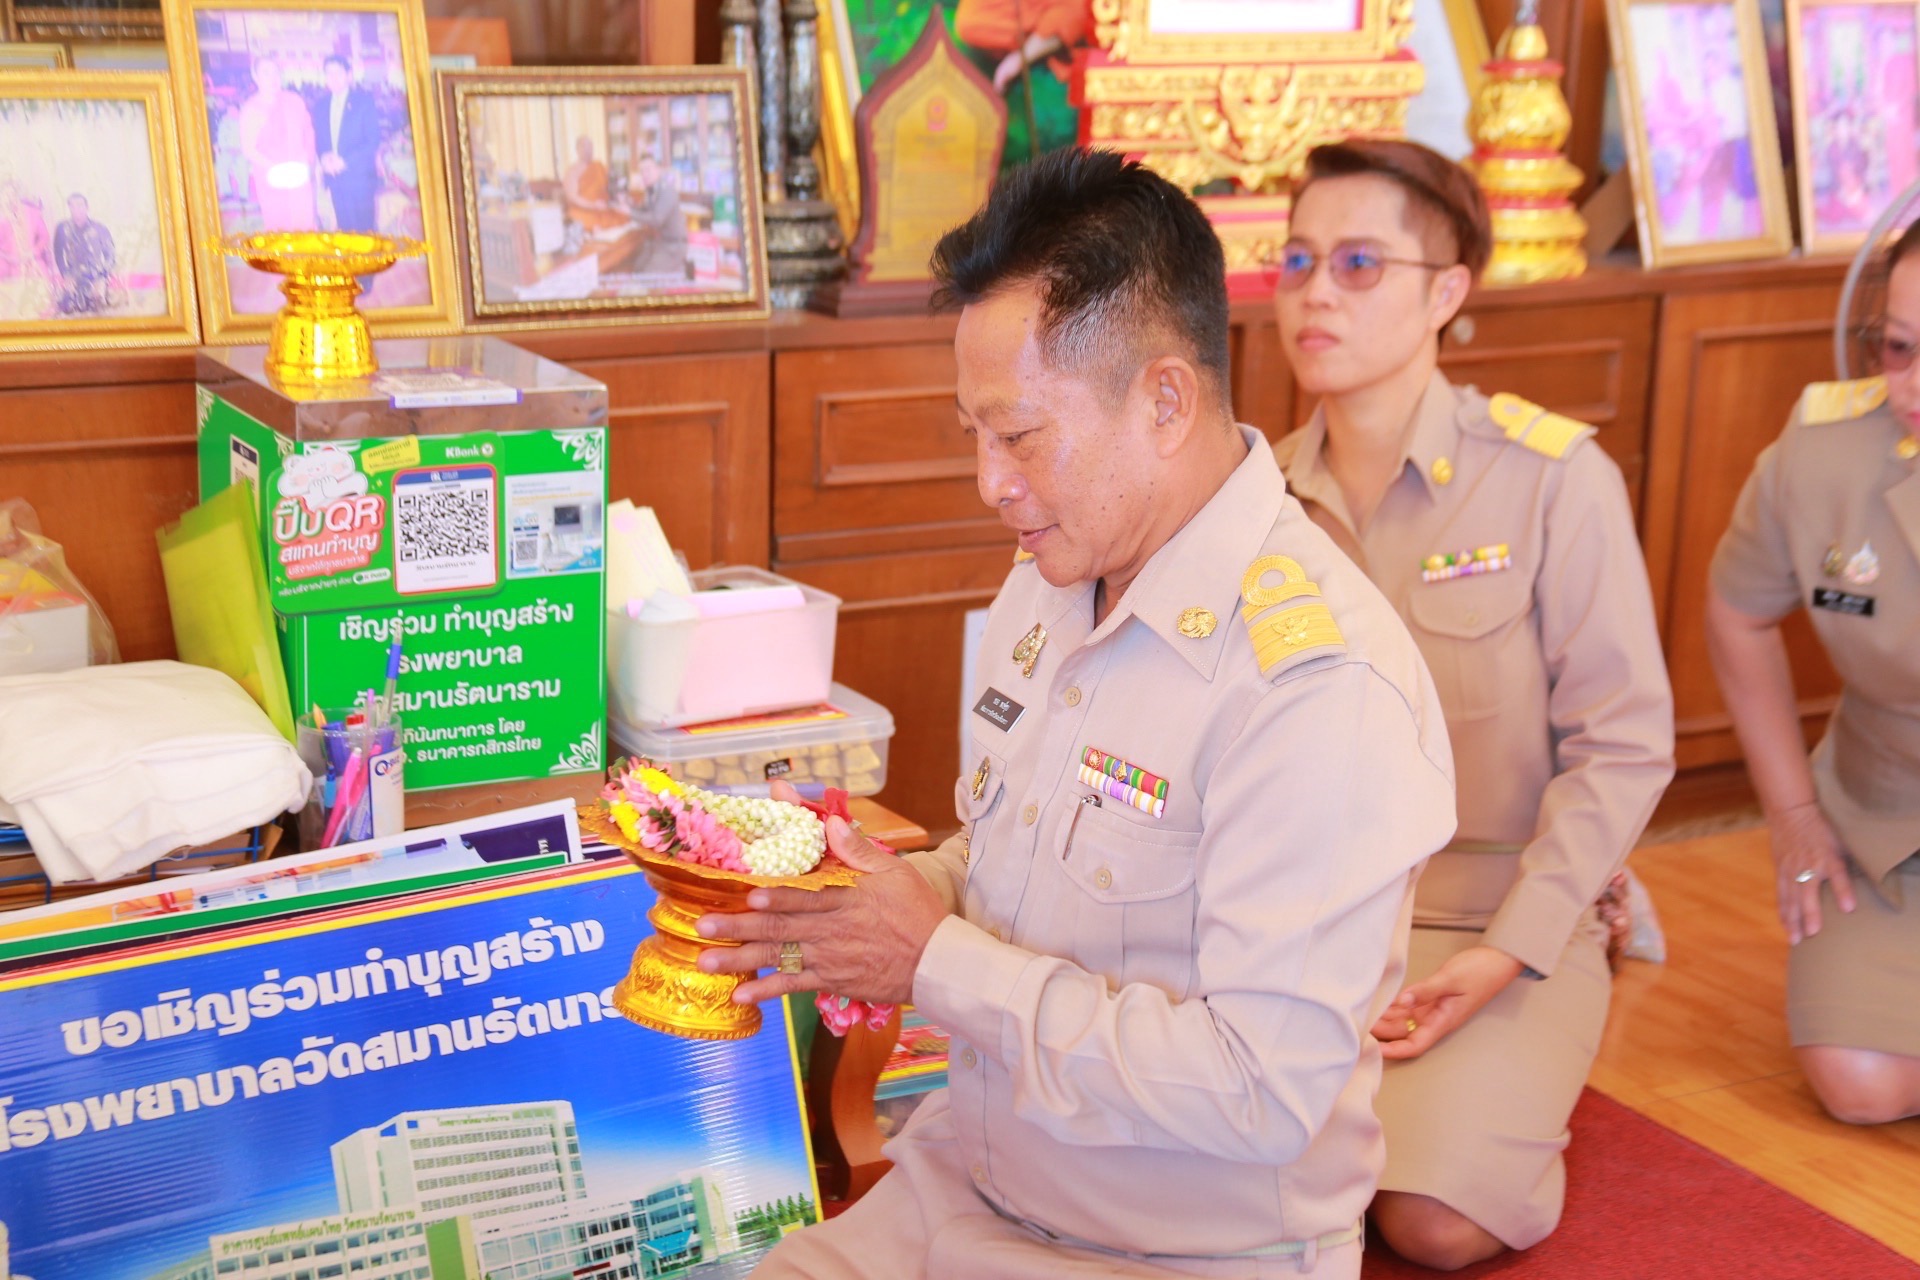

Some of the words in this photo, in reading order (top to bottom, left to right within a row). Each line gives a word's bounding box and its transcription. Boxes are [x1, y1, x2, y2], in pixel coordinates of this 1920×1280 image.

[445, 444, 479, 458] KBank
[280, 532, 377, 562] สแกนทำบุญ
[339, 609, 437, 642] เชิญร่วม
[444, 598, 574, 637] ทำบุญสร้าง
[386, 644, 523, 674] รงพยาบาล
[403, 721, 495, 745] ภินันทนาการ
[498, 717, 526, 734] โดย
[417, 735, 542, 762] ธนาคารกสิกรไทย
[62, 917, 605, 1055] ขอเชิญร่วมทำบุญสร้าง
